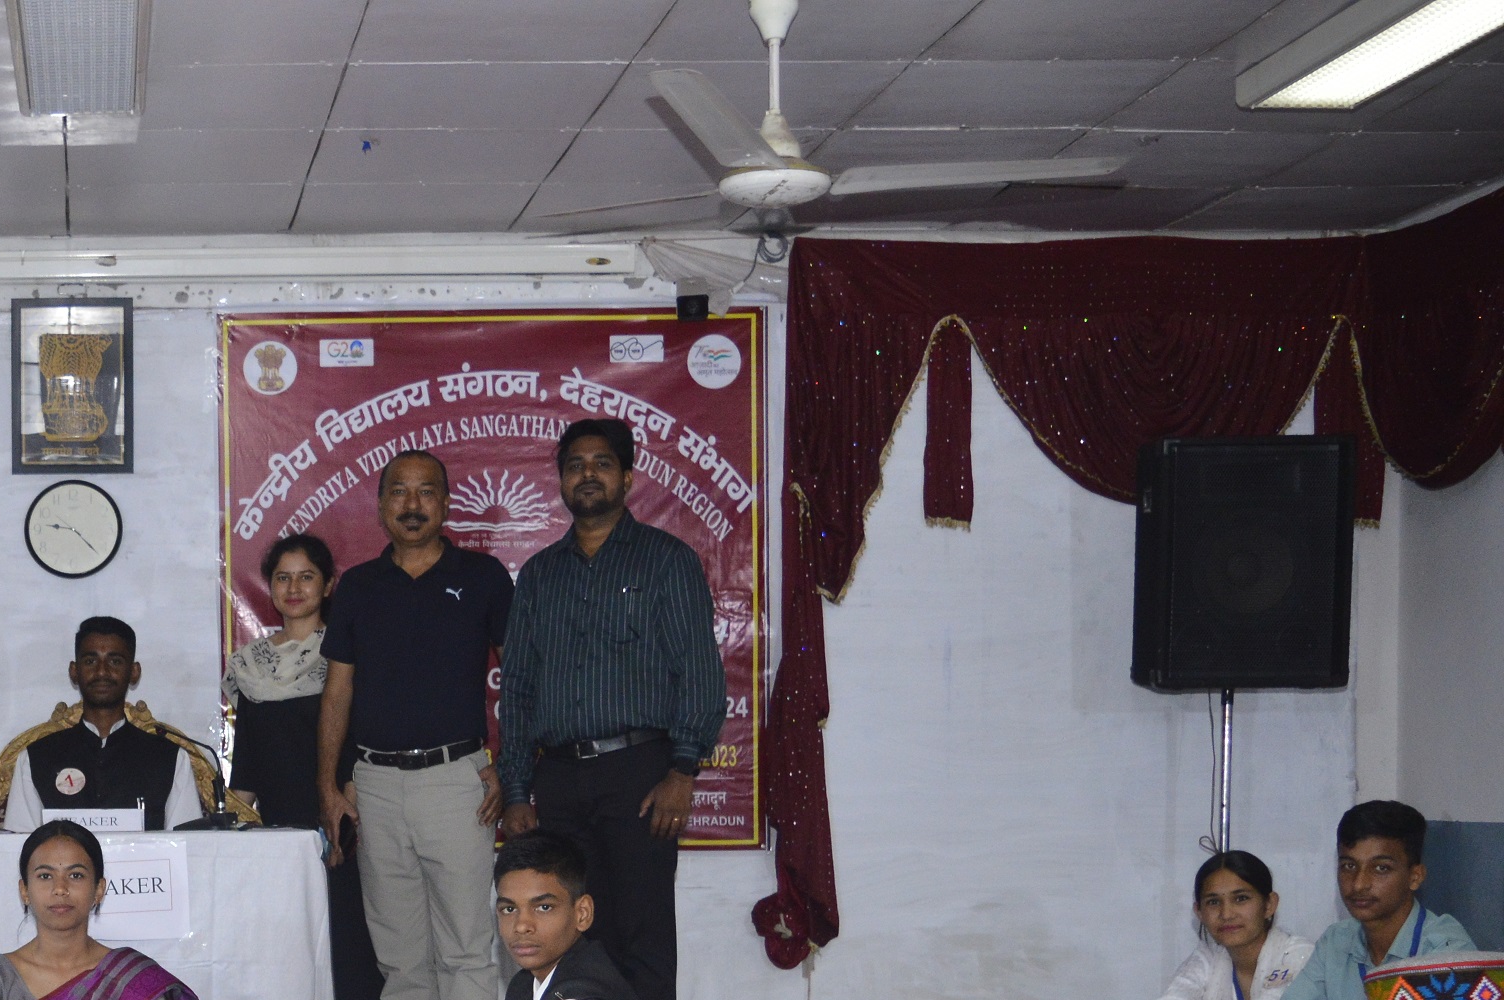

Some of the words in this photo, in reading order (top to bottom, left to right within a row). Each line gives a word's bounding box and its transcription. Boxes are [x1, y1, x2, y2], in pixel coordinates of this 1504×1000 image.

[315, 380, 431, 452] विद्यालय
[560, 367, 676, 446] देहरादून
[678, 426, 756, 513] संभाग
[672, 475, 733, 542] REGION
[726, 696, 748, 718] 24
[692, 791, 727, 810] हरादून
[688, 815, 745, 827] EHRADUN
[104, 877, 165, 896] AKER
[1268, 969, 1289, 981] 51
